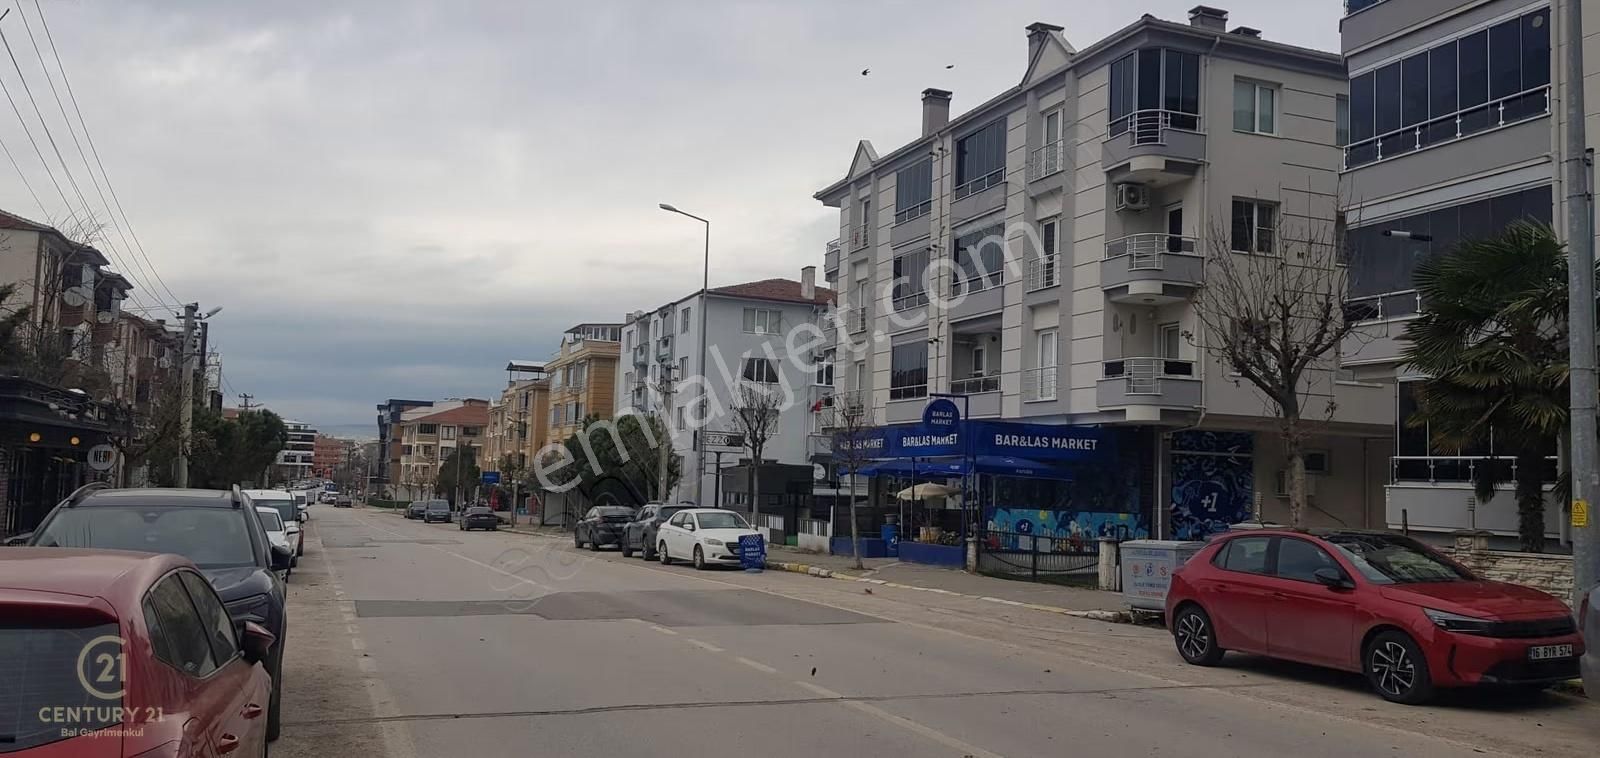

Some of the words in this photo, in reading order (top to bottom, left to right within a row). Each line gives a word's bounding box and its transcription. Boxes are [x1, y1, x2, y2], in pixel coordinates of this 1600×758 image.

[931, 418, 953, 426] MARKET
[902, 435, 931, 447] BAR&LAS
[995, 434, 1049, 448] BAR&LAS
[1052, 437, 1098, 450] MARKET
[1200, 492, 1219, 513] +1
